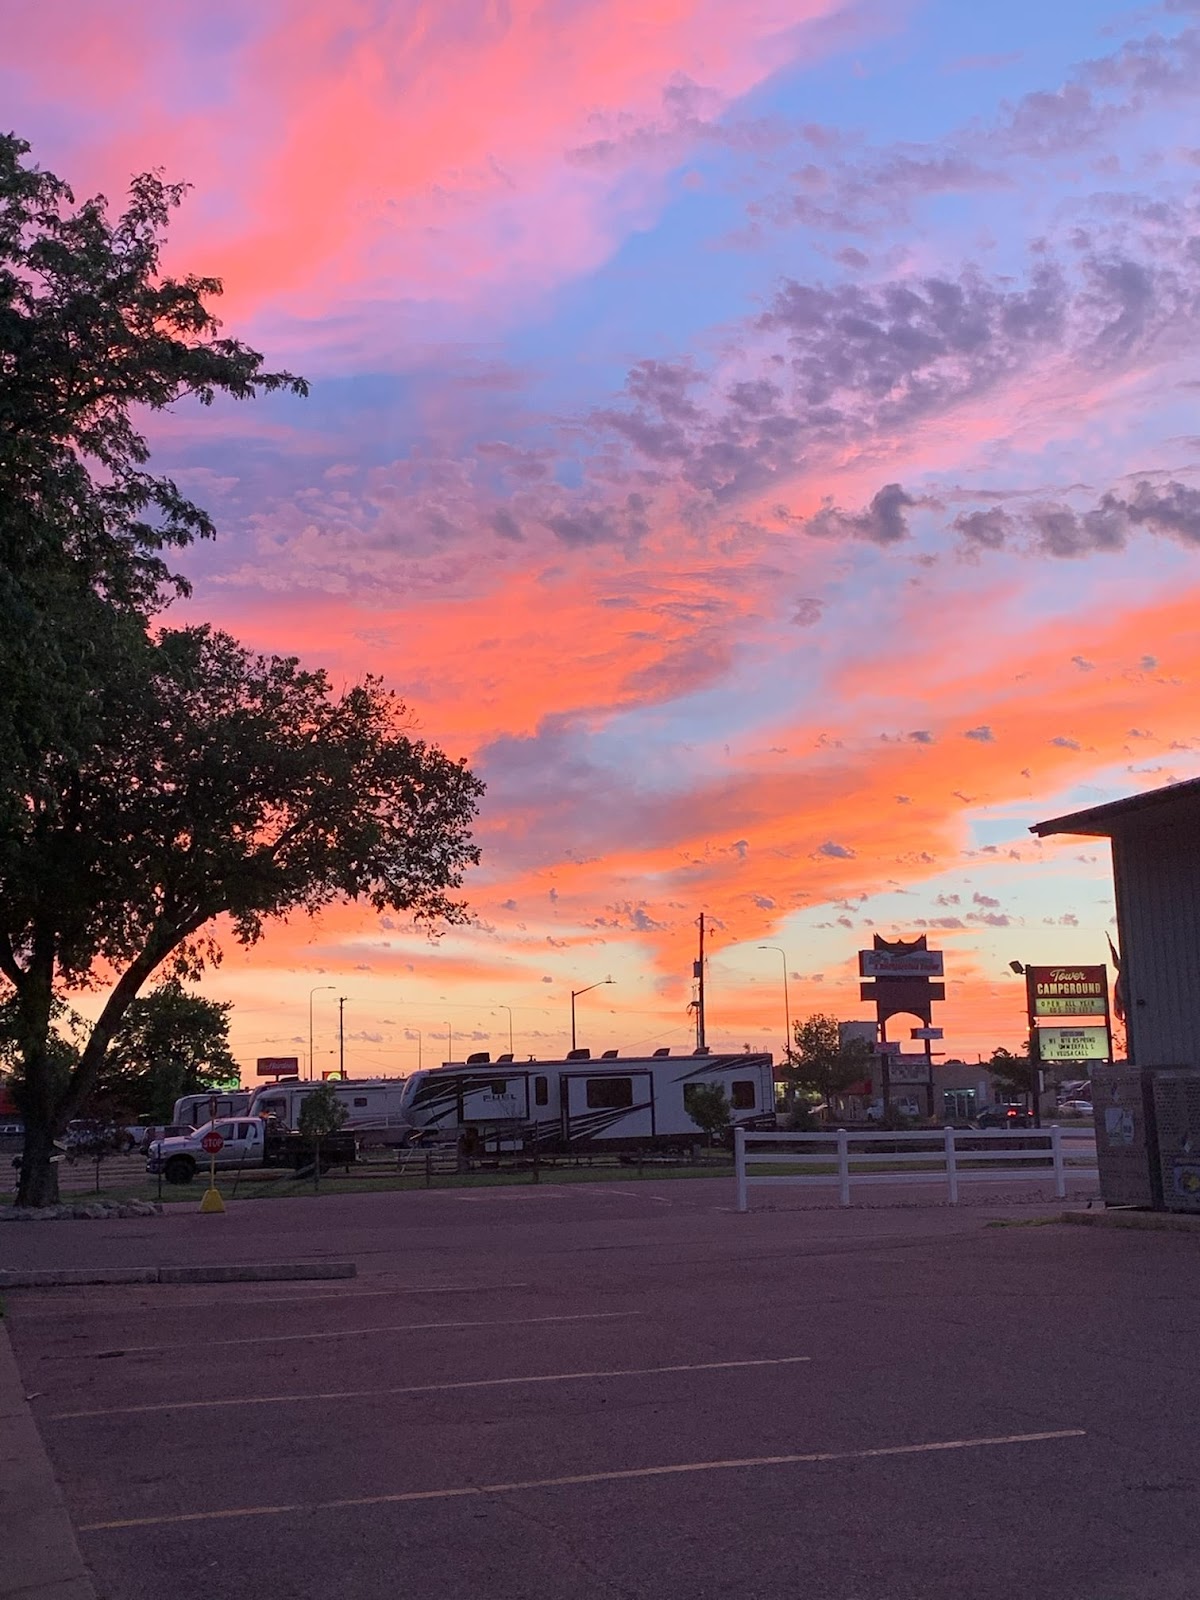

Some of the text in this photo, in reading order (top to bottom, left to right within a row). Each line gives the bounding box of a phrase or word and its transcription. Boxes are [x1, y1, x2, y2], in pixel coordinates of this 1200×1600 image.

[1050, 969, 1087, 982] Tower
[1037, 983, 1101, 995] CAMPGROUND
[203, 1138, 223, 1148] STOP
